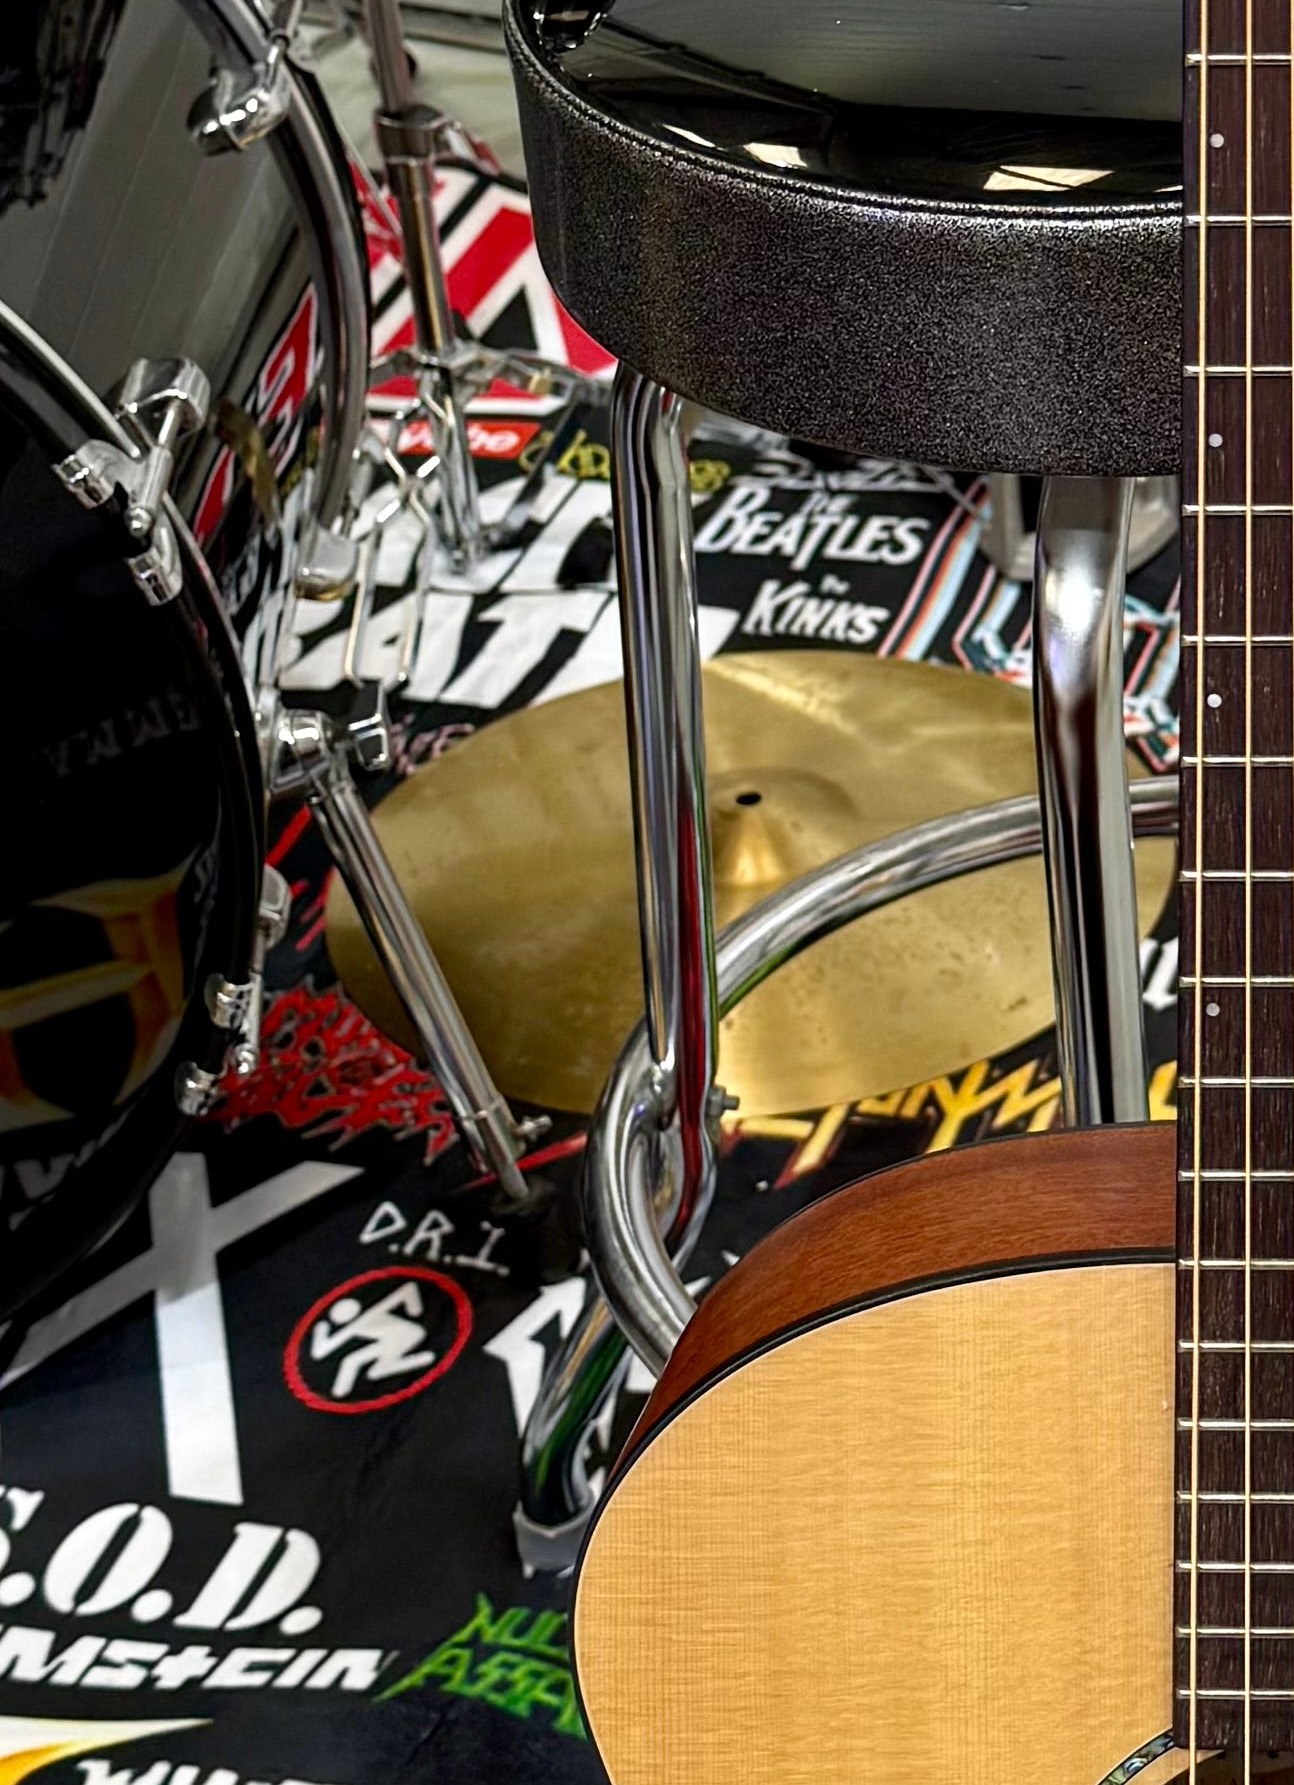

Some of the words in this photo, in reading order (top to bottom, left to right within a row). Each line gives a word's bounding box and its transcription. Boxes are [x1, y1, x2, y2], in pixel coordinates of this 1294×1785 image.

[693, 486, 931, 571] BEATLES
[741, 578, 891, 644] KINKS
[359, 1200, 511, 1277] D.R.I.
[0, 1502, 323, 1636] .O.D.
[0, 1625, 400, 1691] MSTEIN
